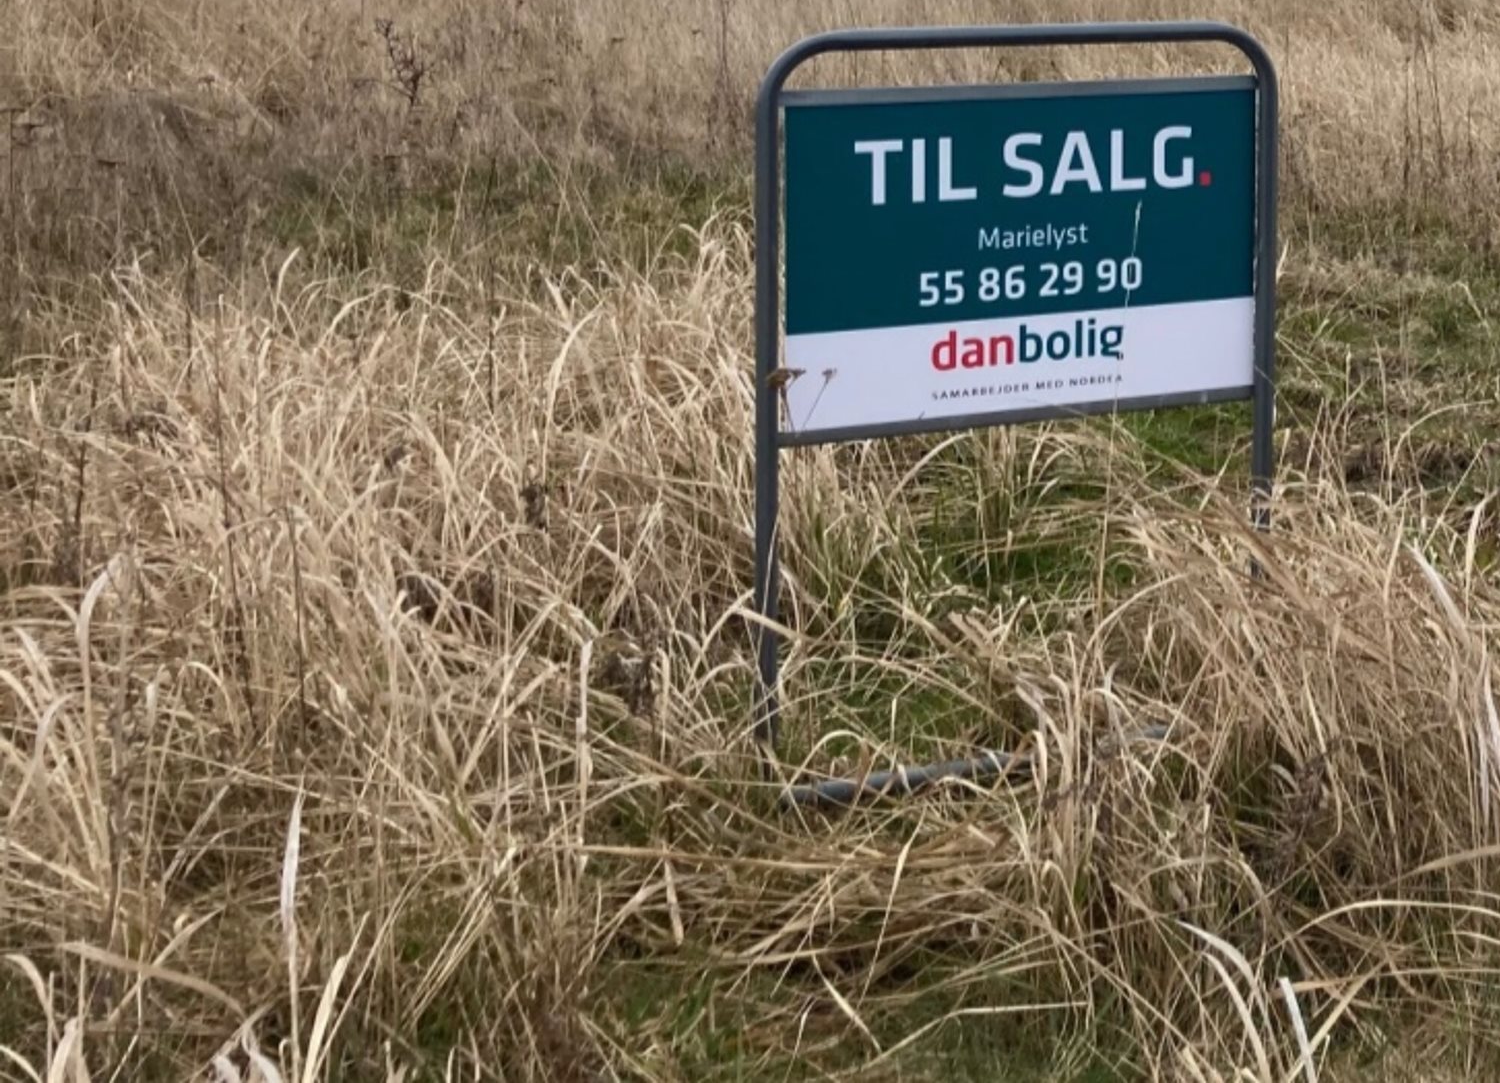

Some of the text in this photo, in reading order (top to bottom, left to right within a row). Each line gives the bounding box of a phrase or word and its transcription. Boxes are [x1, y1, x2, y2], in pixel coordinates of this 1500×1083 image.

[854, 125, 1211, 205] TIL SALG.
[978, 223, 1088, 250] Marielyst
[919, 256, 1143, 307] 55 86 29 90
[931, 318, 1124, 371] danbolig
[1035, 379, 1064, 391] MED
